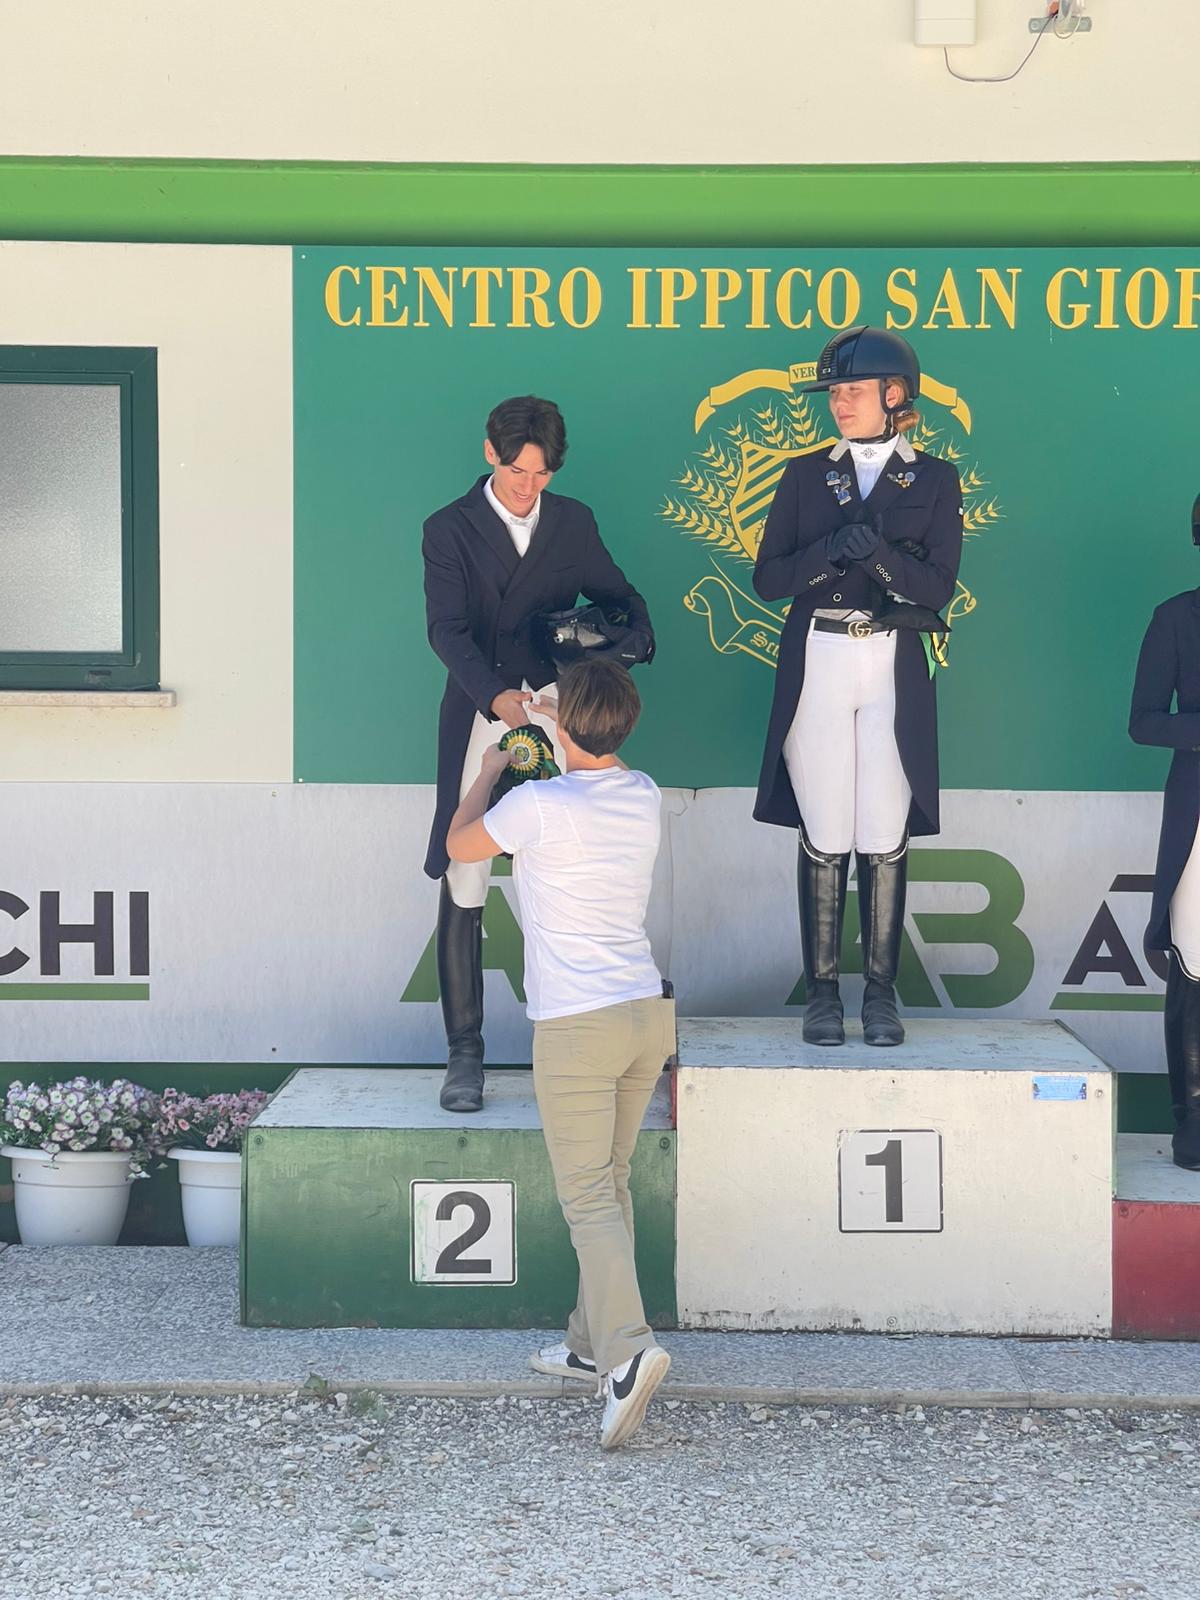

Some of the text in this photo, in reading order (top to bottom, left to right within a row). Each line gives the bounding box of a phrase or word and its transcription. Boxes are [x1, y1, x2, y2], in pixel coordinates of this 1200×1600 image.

[324, 265, 602, 328] CENTRO
[626, 267, 861, 329] IPPICO
[886, 267, 1022, 329] SAN
[400, 856, 528, 1003] A
[1061, 899, 1168, 987] A
[864, 1139, 904, 1223] 1
[434, 1190, 492, 1274] 2
